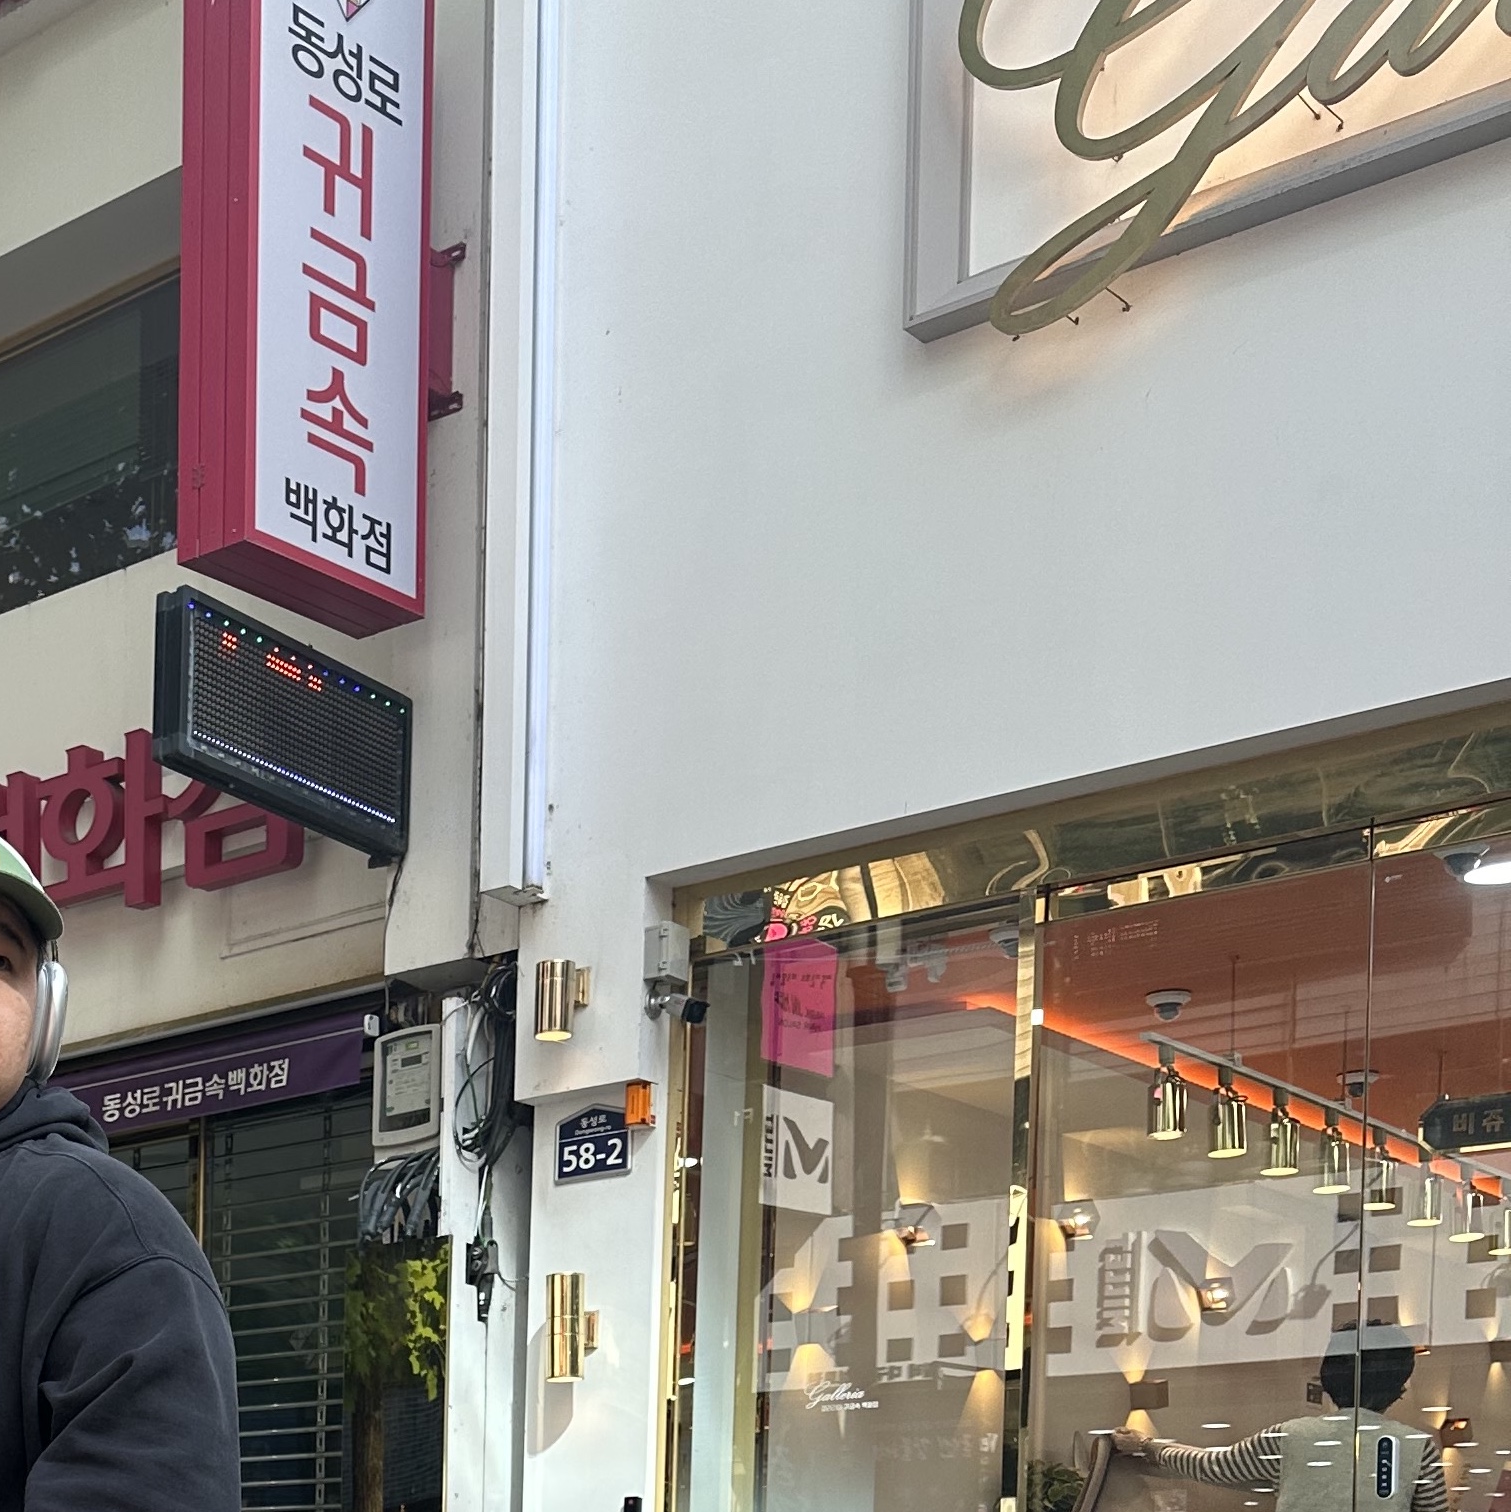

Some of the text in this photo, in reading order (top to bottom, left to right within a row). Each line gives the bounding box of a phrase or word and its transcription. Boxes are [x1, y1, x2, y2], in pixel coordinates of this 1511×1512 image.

[287, 2, 404, 127] 동성로
[299, 95, 376, 498] 귀금속
[284, 476, 393, 576] 백화점
[580, 1115, 607, 1128] 동성로
[562, 1138, 623, 1173] 58-2
[804, 1381, 865, 1409] Galleria
